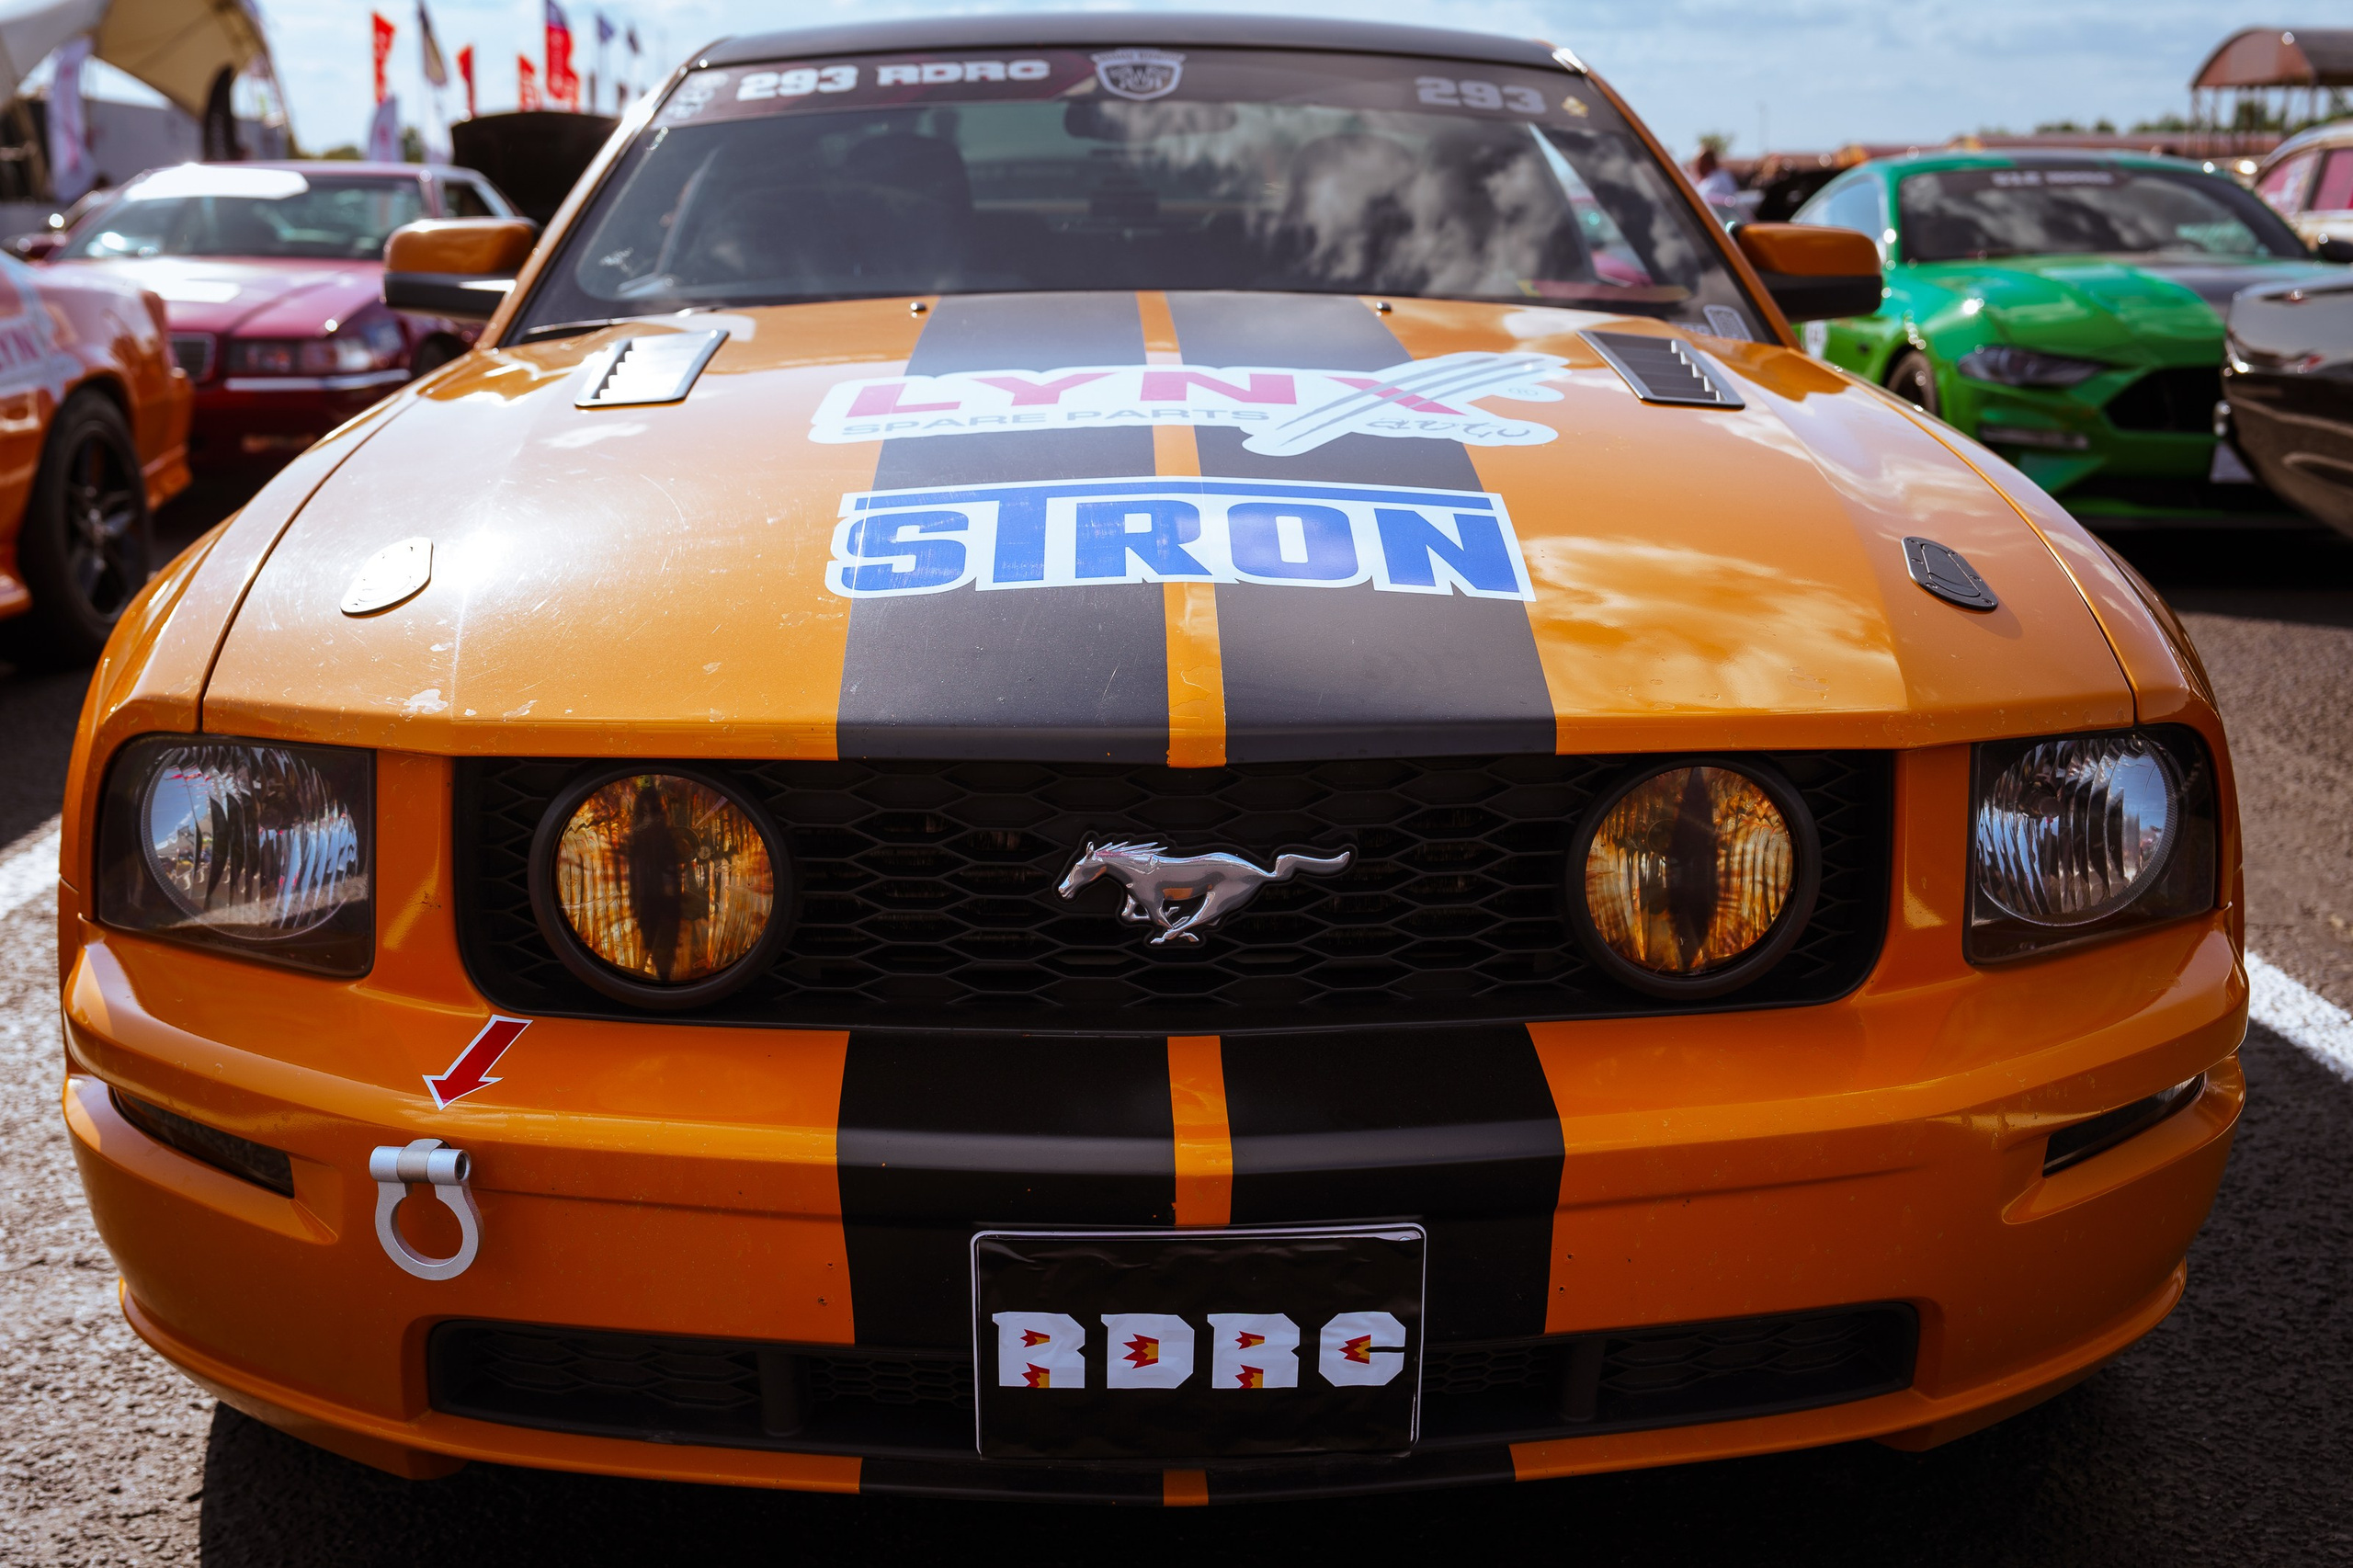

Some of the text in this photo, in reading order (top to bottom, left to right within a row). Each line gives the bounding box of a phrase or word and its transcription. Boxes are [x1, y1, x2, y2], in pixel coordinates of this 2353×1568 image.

[736, 65, 858, 101] 293
[877, 60, 1050, 85] RDRC
[1414, 76, 1547, 114] 293
[846, 366, 1487, 423] LYNX
[842, 409, 1268, 436] SPARE PARTS
[840, 482, 1519, 593] STRON
[992, 1312, 1406, 1389] RDRC
